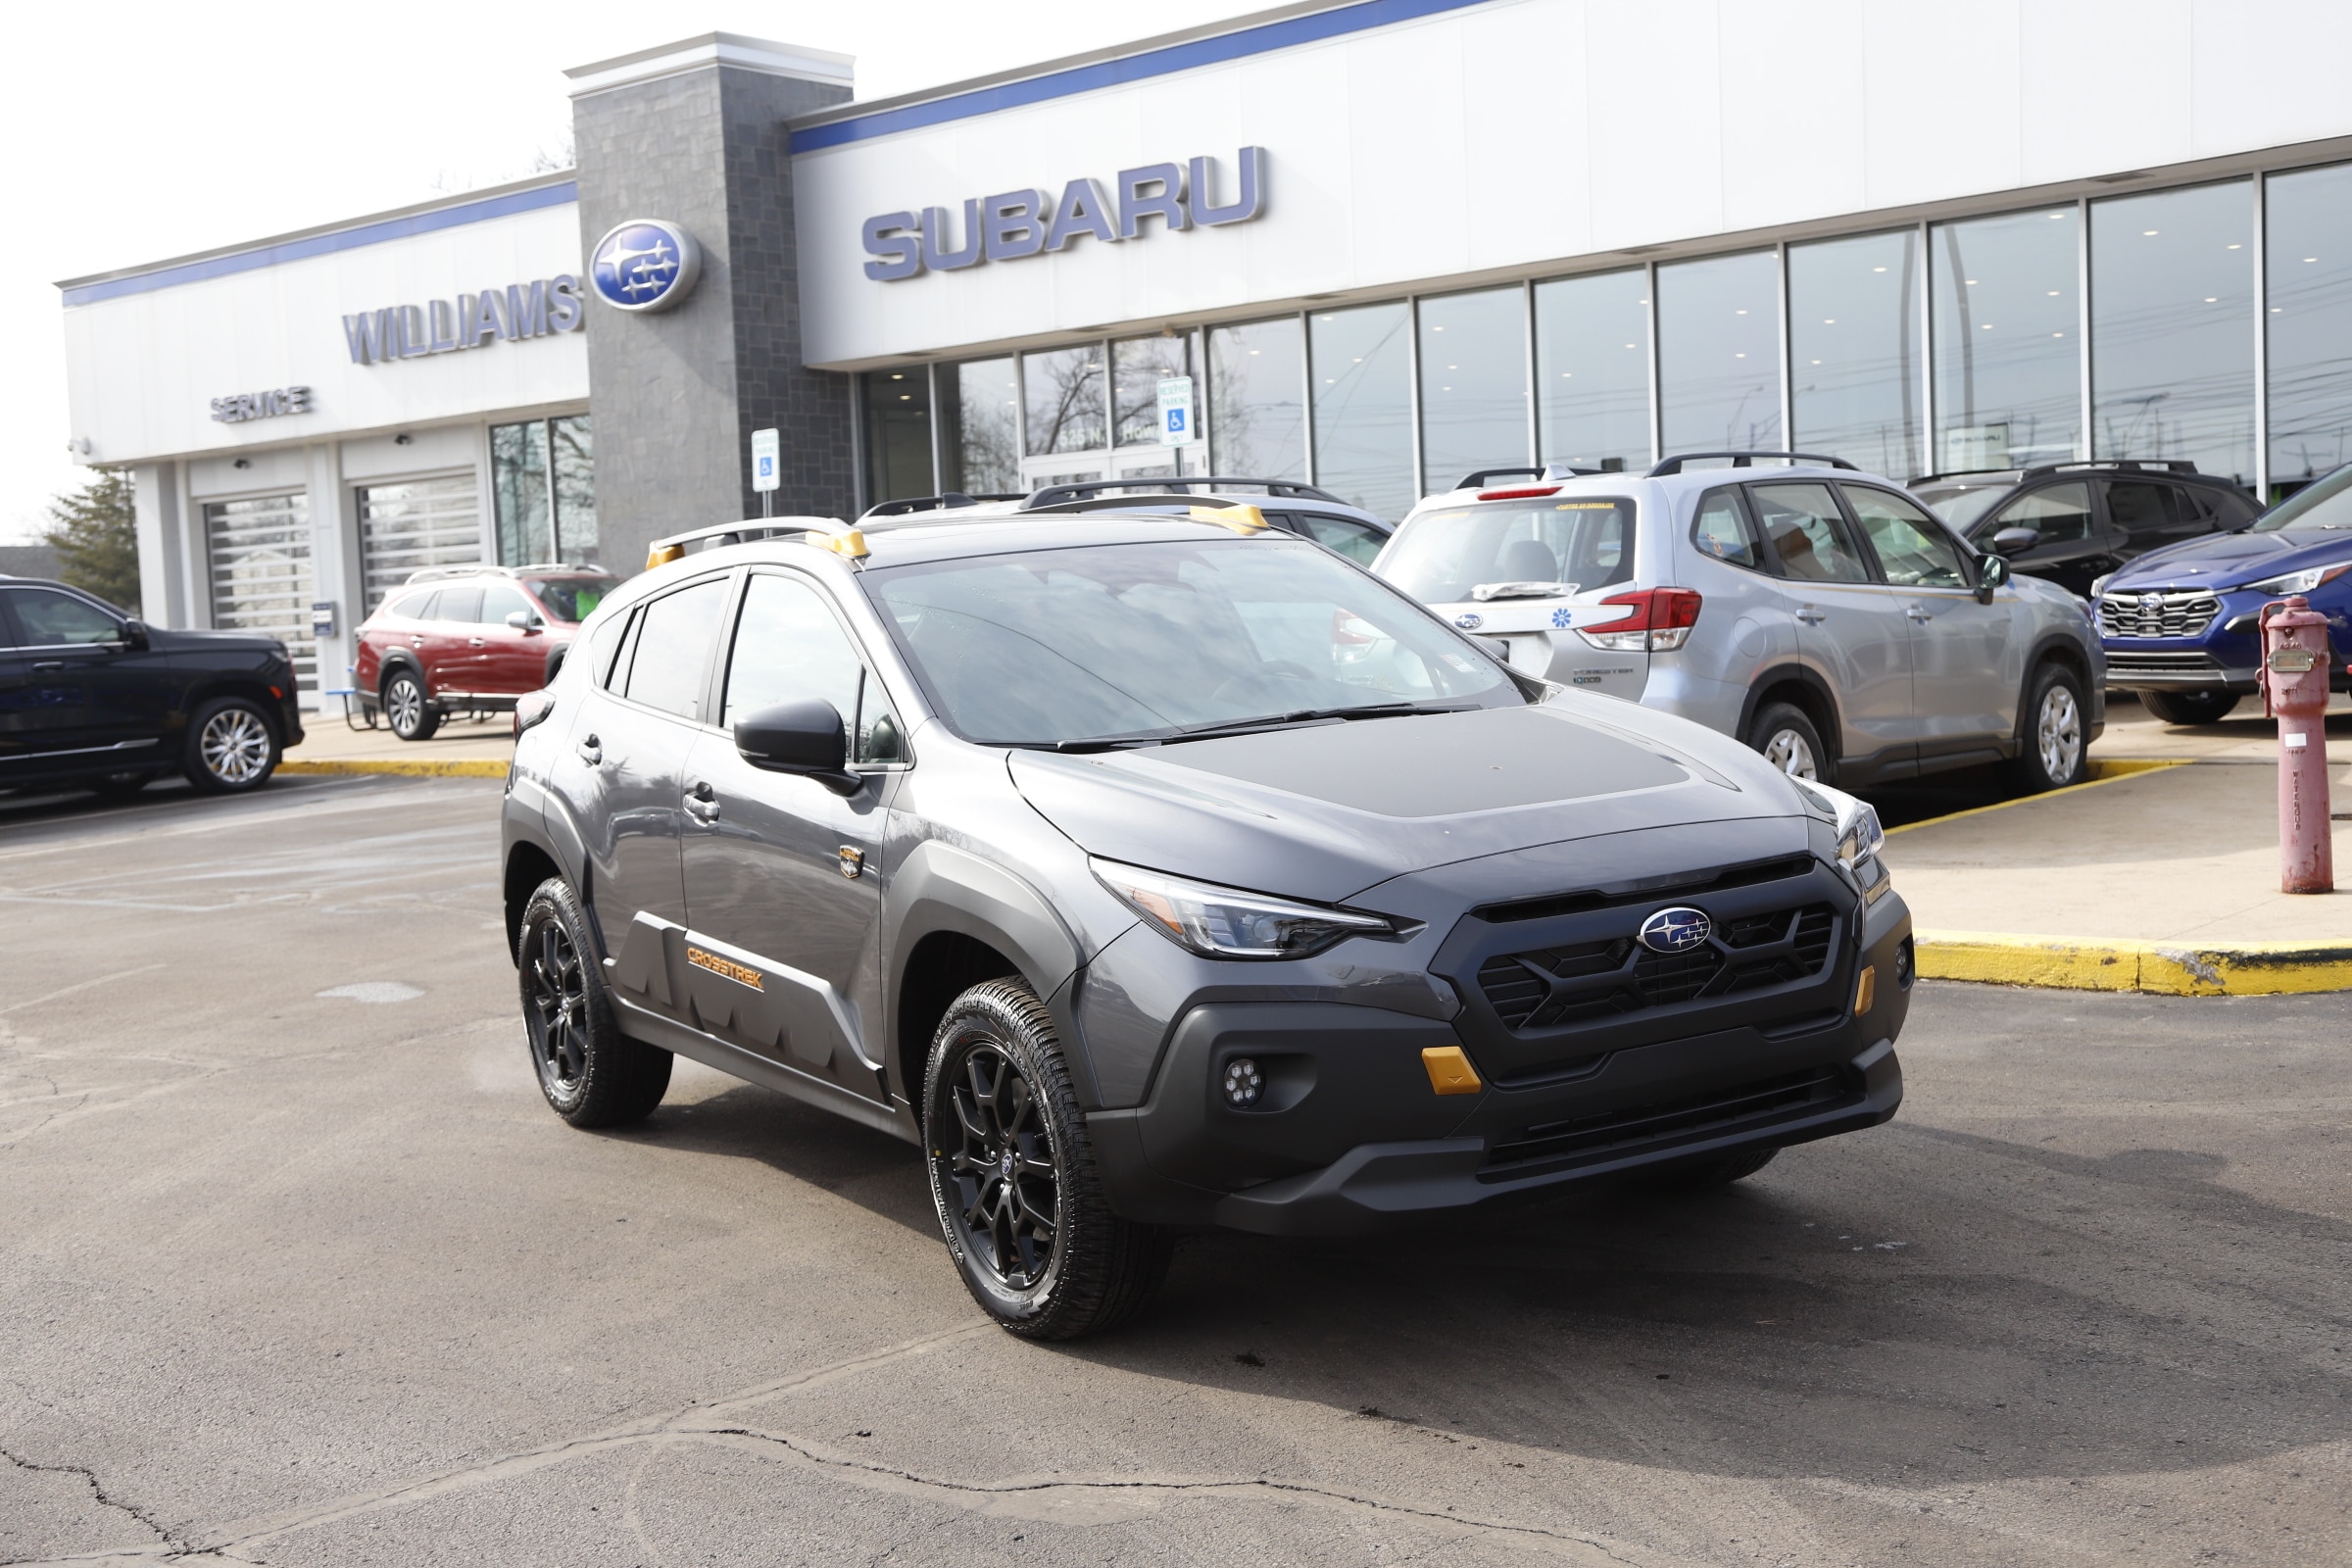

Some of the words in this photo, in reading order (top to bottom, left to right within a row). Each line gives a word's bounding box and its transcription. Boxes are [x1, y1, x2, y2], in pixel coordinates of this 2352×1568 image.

[862, 146, 1265, 282] SUBARU
[342, 274, 585, 366] WILLIAMS
[211, 387, 311, 422] SERVICE
[1159, 383, 1189, 395] RESERVED
[1162, 396, 1188, 406] PARKING
[1058, 428, 1085, 447] 525
[687, 947, 763, 990] CROSSTREK
